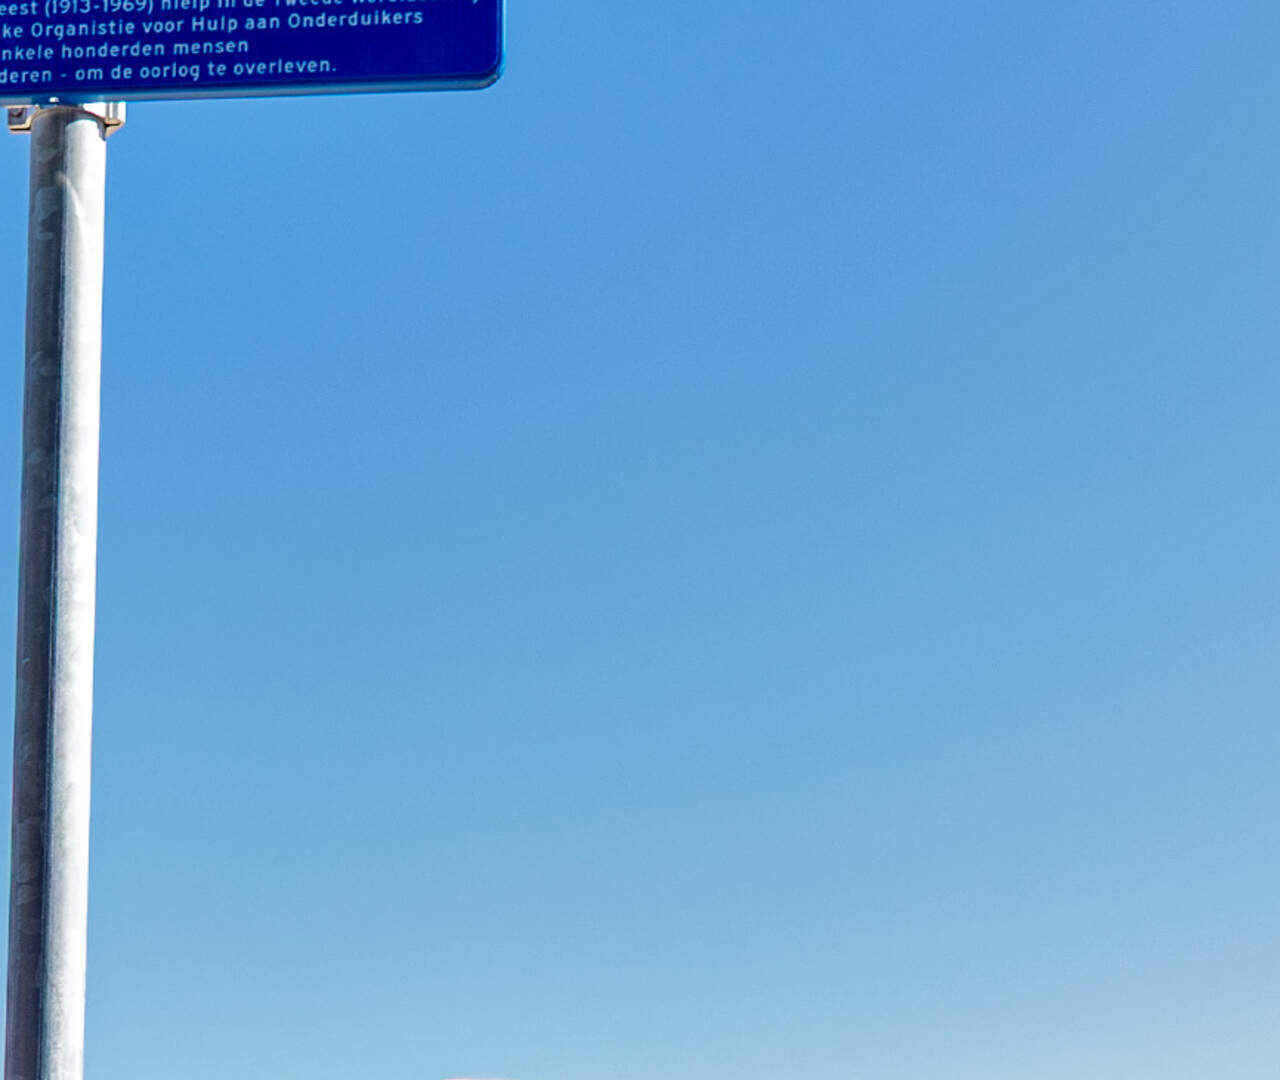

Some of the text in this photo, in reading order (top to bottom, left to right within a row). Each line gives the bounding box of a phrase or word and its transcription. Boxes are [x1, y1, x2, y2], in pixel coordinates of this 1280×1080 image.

[44, 0, 154, 18] (1913-1969)
[31, 19, 135, 41] Organistie
[142, 20, 184, 34] voor
[191, 15, 238, 33] Hulp
[244, 16, 280, 30] aan
[287, 9, 423, 29] Onderduikers
[61, 41, 165, 59] honderden
[173, 40, 249, 55] mensen
[75, 68, 103, 81] om
[110, 64, 133, 80] de
[139, 62, 200, 82] oorlog
[207, 61, 227, 76] te
[233, 58, 337, 75] overleven.
